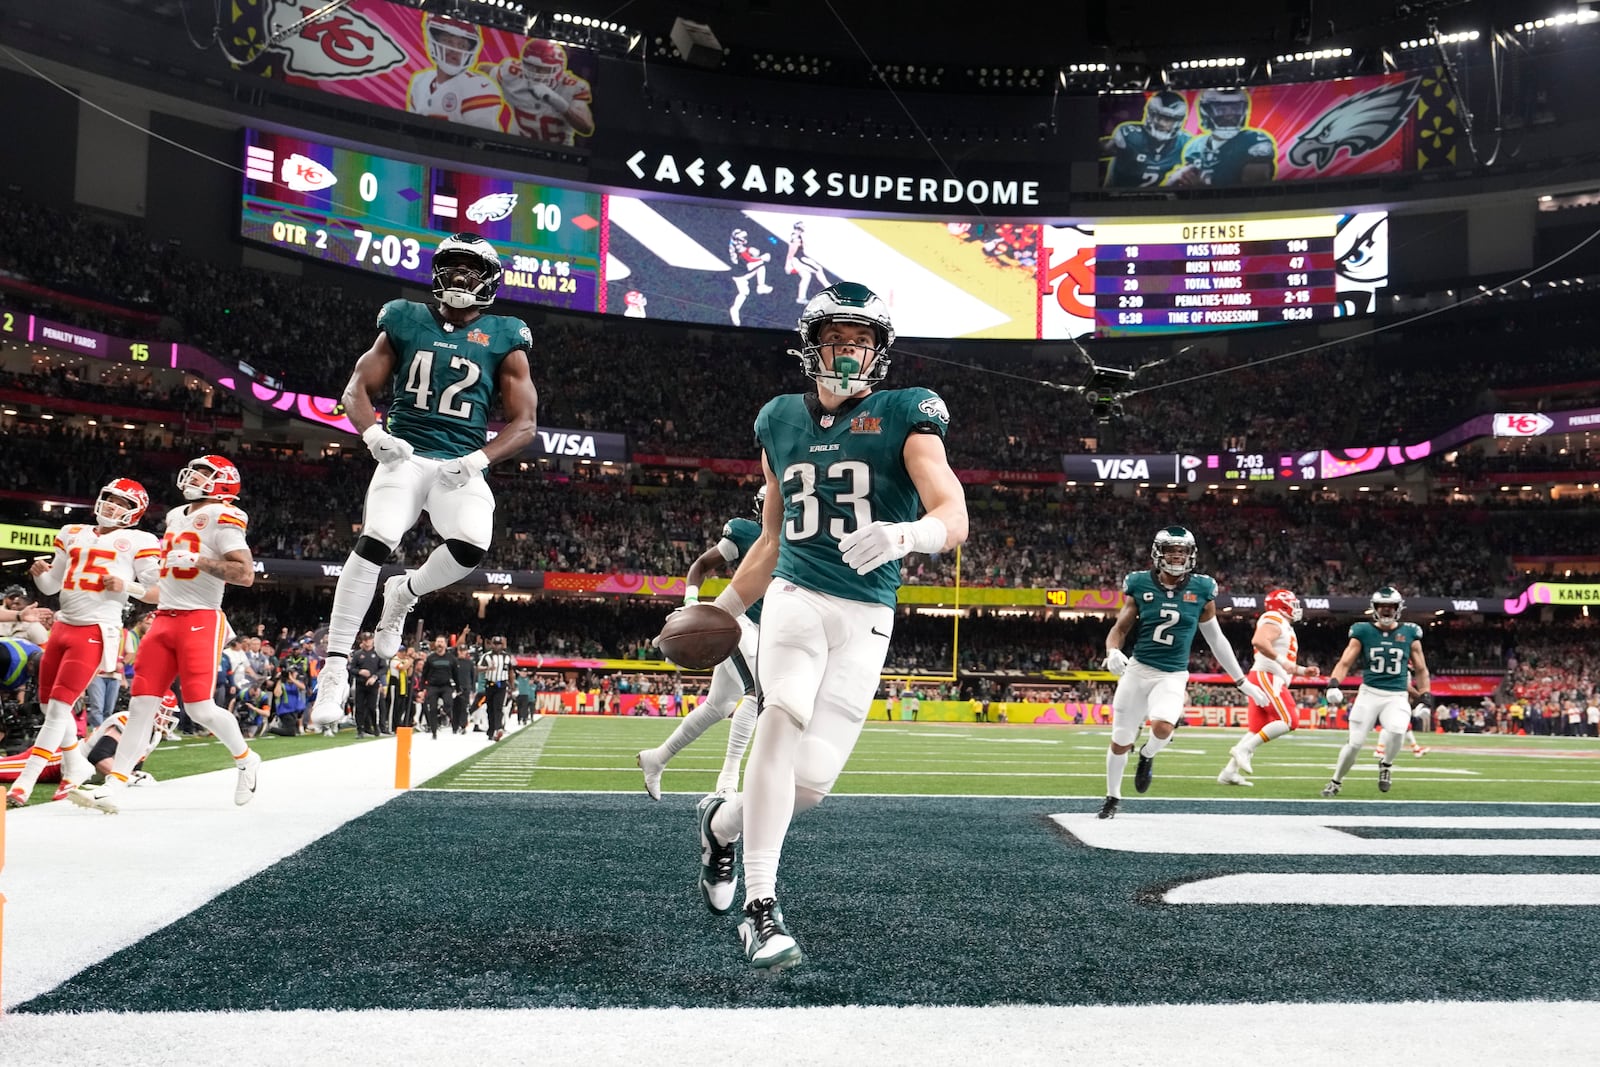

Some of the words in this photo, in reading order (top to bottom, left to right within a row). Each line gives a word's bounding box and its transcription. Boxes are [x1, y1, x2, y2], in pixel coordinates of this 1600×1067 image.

[625, 149, 827, 197] CAESARS
[827, 171, 1040, 206] SUPERDOME
[359, 172, 378, 202] 0
[532, 202, 561, 232] 10
[1182, 224, 1246, 240] OFFENSE
[272, 221, 307, 246] QTR
[315, 229, 328, 250] 2
[354, 229, 421, 270] 7:03
[1186, 244, 1209, 257] PASS
[1210, 243, 1241, 256] YARDS
[512, 255, 539, 273] 3RD
[541, 258, 551, 275] &
[554, 261, 570, 277] 16
[1127, 262, 1136, 275] 2
[1186, 260, 1209, 274] RUSH
[1210, 259, 1242, 273] YARDS
[1289, 256, 1305, 269] 47
[504, 270, 535, 289] BALL
[538, 275, 557, 291] ON
[558, 278, 576, 294] 24
[1124, 279, 1139, 292] 20
[1184, 277, 1210, 290] TOTAL
[1210, 275, 1242, 289] YARDS
[1286, 273, 1308, 286] 151
[1175, 292, 1252, 308] PENALTIES-YARDS
[1284, 290, 1310, 304] 2-15
[3, 312, 14, 333] 2
[1168, 311, 1189, 324] TIME
[1190, 310, 1203, 323] OF
[1204, 308, 1259, 323] POSSESSION
[43, 326, 74, 344] PENALTY
[73, 333, 97, 349] YARDS
[129, 343, 149, 361] 15
[405, 350, 481, 419] 42
[538, 431, 597, 457] VISA
[809, 443, 840, 452] EAGLES
[1091, 459, 1149, 480] VISA
[1236, 454, 1264, 468] 7:03
[1187, 469, 1196, 482] 0
[1301, 466, 1316, 480] 10
[783, 460, 872, 541] 33
[11, 530, 57, 547] PHILA
[63, 547, 117, 593] 15
[321, 564, 343, 576] VIS
[485, 572, 513, 585] VISA
[1047, 590, 1067, 605] 40
[1232, 597, 1256, 608] VISA
[1305, 598, 1330, 609] VISA
[1559, 589, 1600, 600] KANSA
[1452, 600, 1479, 611] VISA
[1152, 609, 1181, 646] 2
[1370, 647, 1403, 675] 53
